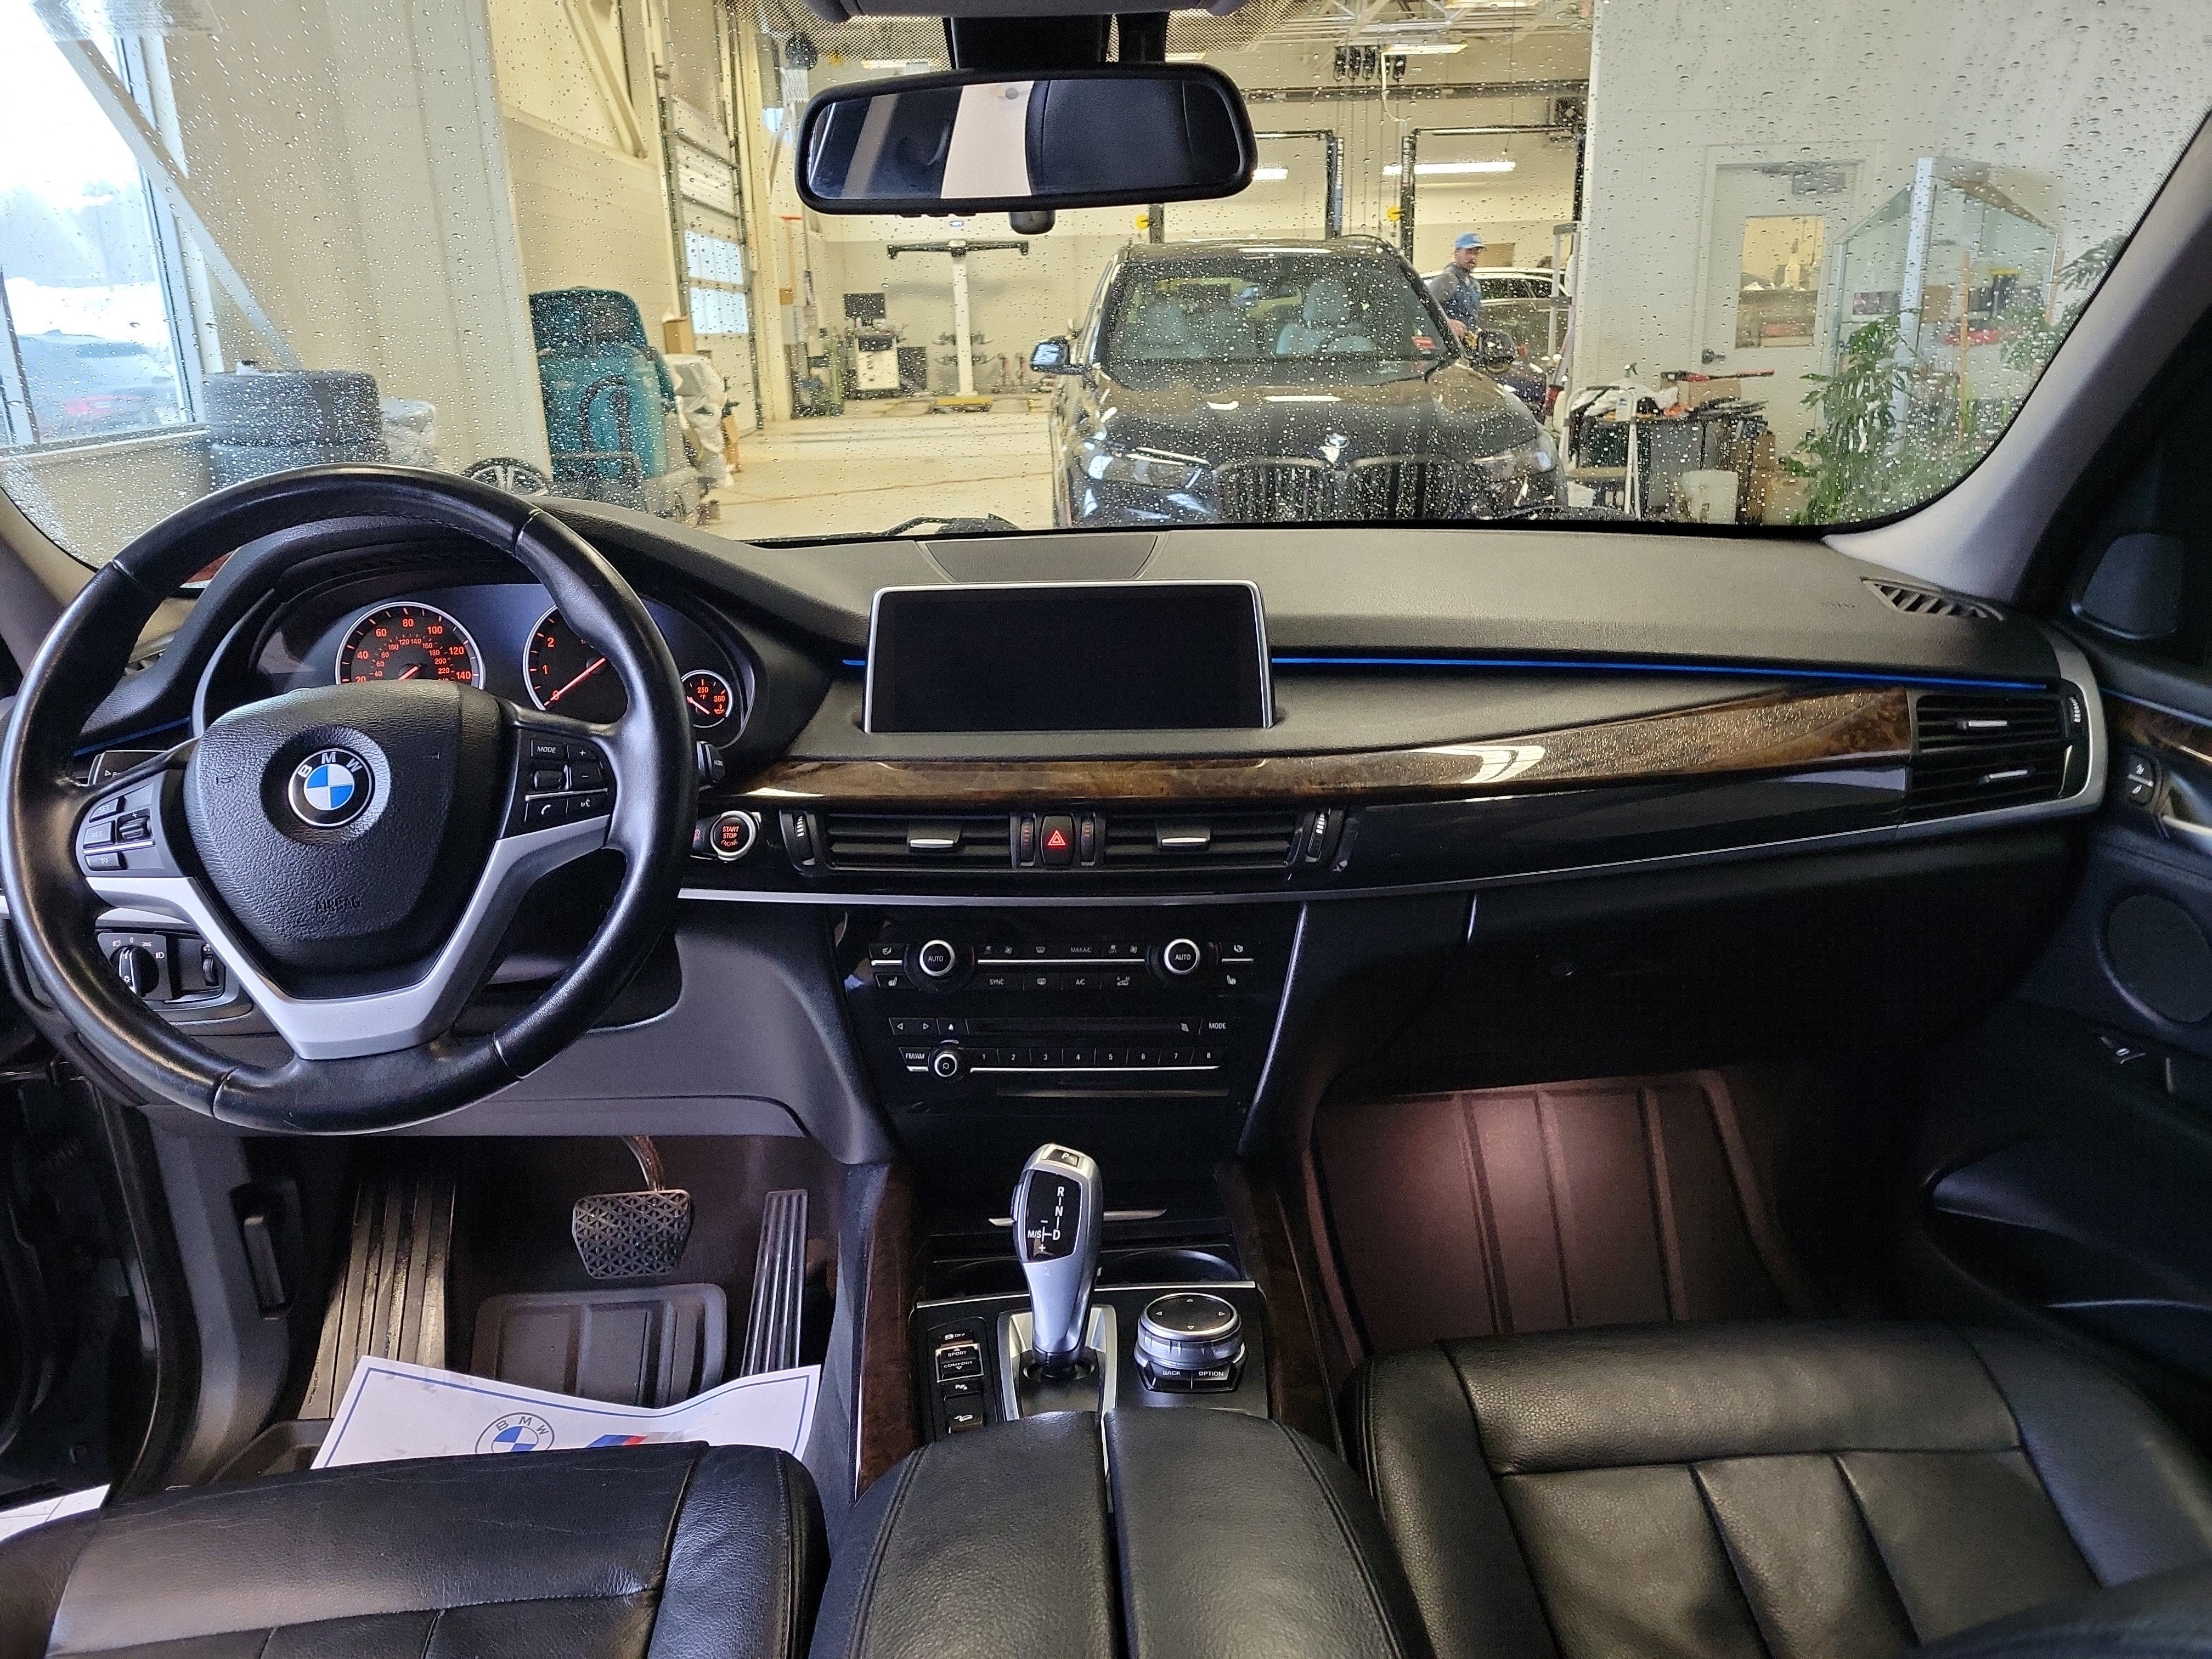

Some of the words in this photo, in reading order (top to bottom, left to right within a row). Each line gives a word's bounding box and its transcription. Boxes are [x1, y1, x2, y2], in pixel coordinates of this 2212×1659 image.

[402, 618, 414, 628] 80
[375, 629, 387, 637] 60
[427, 626, 443, 634] 100
[547, 637, 555, 647] 2
[357, 650, 369, 659] 40
[449, 646, 464, 655] 120
[542, 664, 548, 674] 1
[456, 670, 471, 680] 140
[297, 752, 363, 778] BMW
[99, 804, 110, 812] SET
[1057, 1186, 1065, 1197] R
[1054, 1206, 1063, 1217] N
[1027, 1229, 1042, 1239] M/S
[1052, 1229, 1061, 1240] D
[944, 1360, 973, 1368] COMFORT
[495, 1416, 549, 1435] BMW
